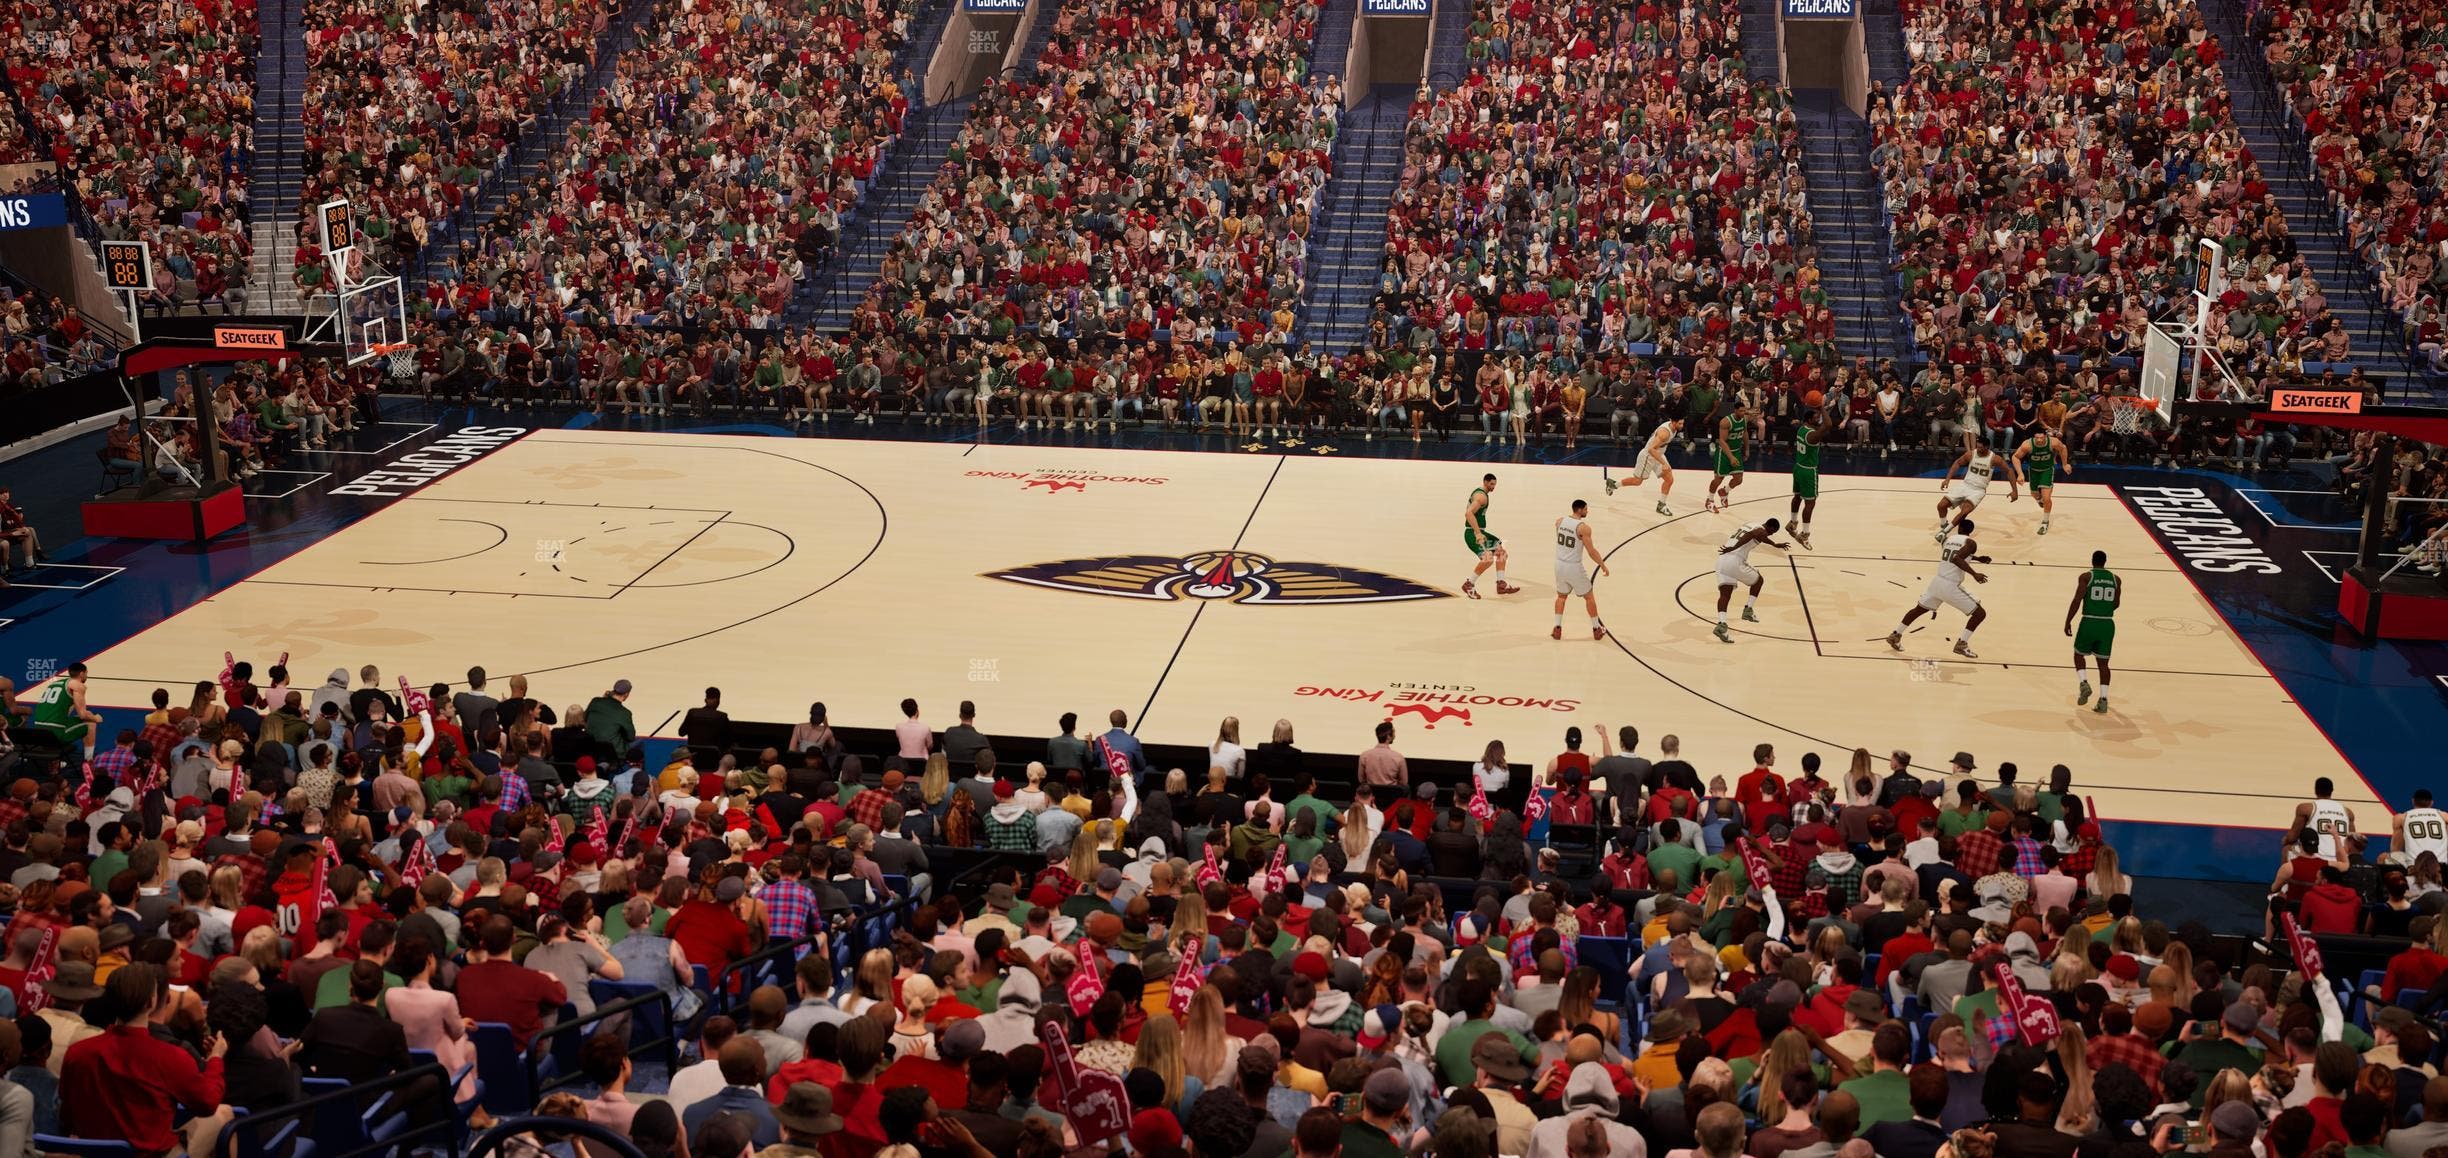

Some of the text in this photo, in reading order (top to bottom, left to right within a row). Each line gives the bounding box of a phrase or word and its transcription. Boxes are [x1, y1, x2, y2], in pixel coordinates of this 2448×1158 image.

[1368, 0, 1427, 10] PELICANS
[1789, 0, 1851, 13] PELICANS
[333, 223, 346, 247] 88
[109, 247, 138, 259] 88 88
[115, 263, 138, 284] 88
[221, 332, 278, 345] SEATGEEK
[2282, 394, 2351, 409] SEATGEEK
[327, 426, 527, 497] PELICANS
[1036, 473, 1170, 486] SMOOTHIE
[2122, 486, 2282, 574] PELICANS
[1557, 532, 1576, 548] 00
[2091, 586, 2116, 601] 00
[1390, 682, 1475, 692] CENTER
[1394, 691, 1582, 712] SMOOTHIE
[2408, 820, 2443, 840] 00
